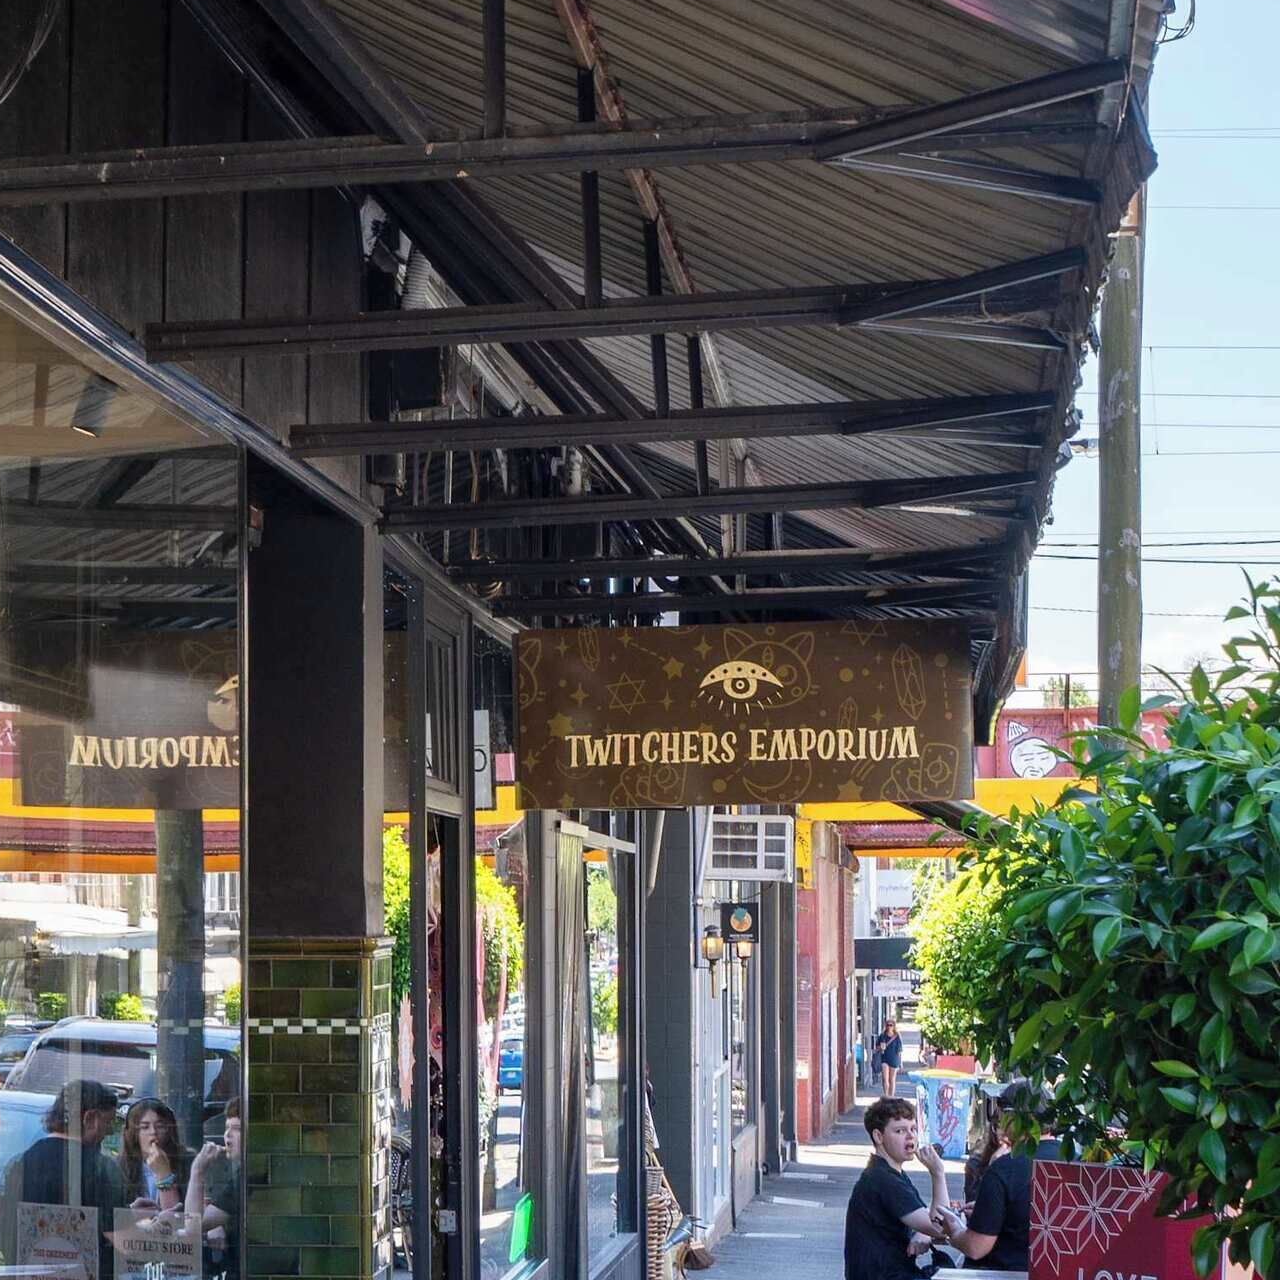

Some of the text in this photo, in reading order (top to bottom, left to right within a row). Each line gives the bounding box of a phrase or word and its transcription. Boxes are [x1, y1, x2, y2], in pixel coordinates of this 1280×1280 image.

[565, 725, 921, 768] TWITCHERS EMPORIUM
[162, 1240, 194, 1255] STORE
